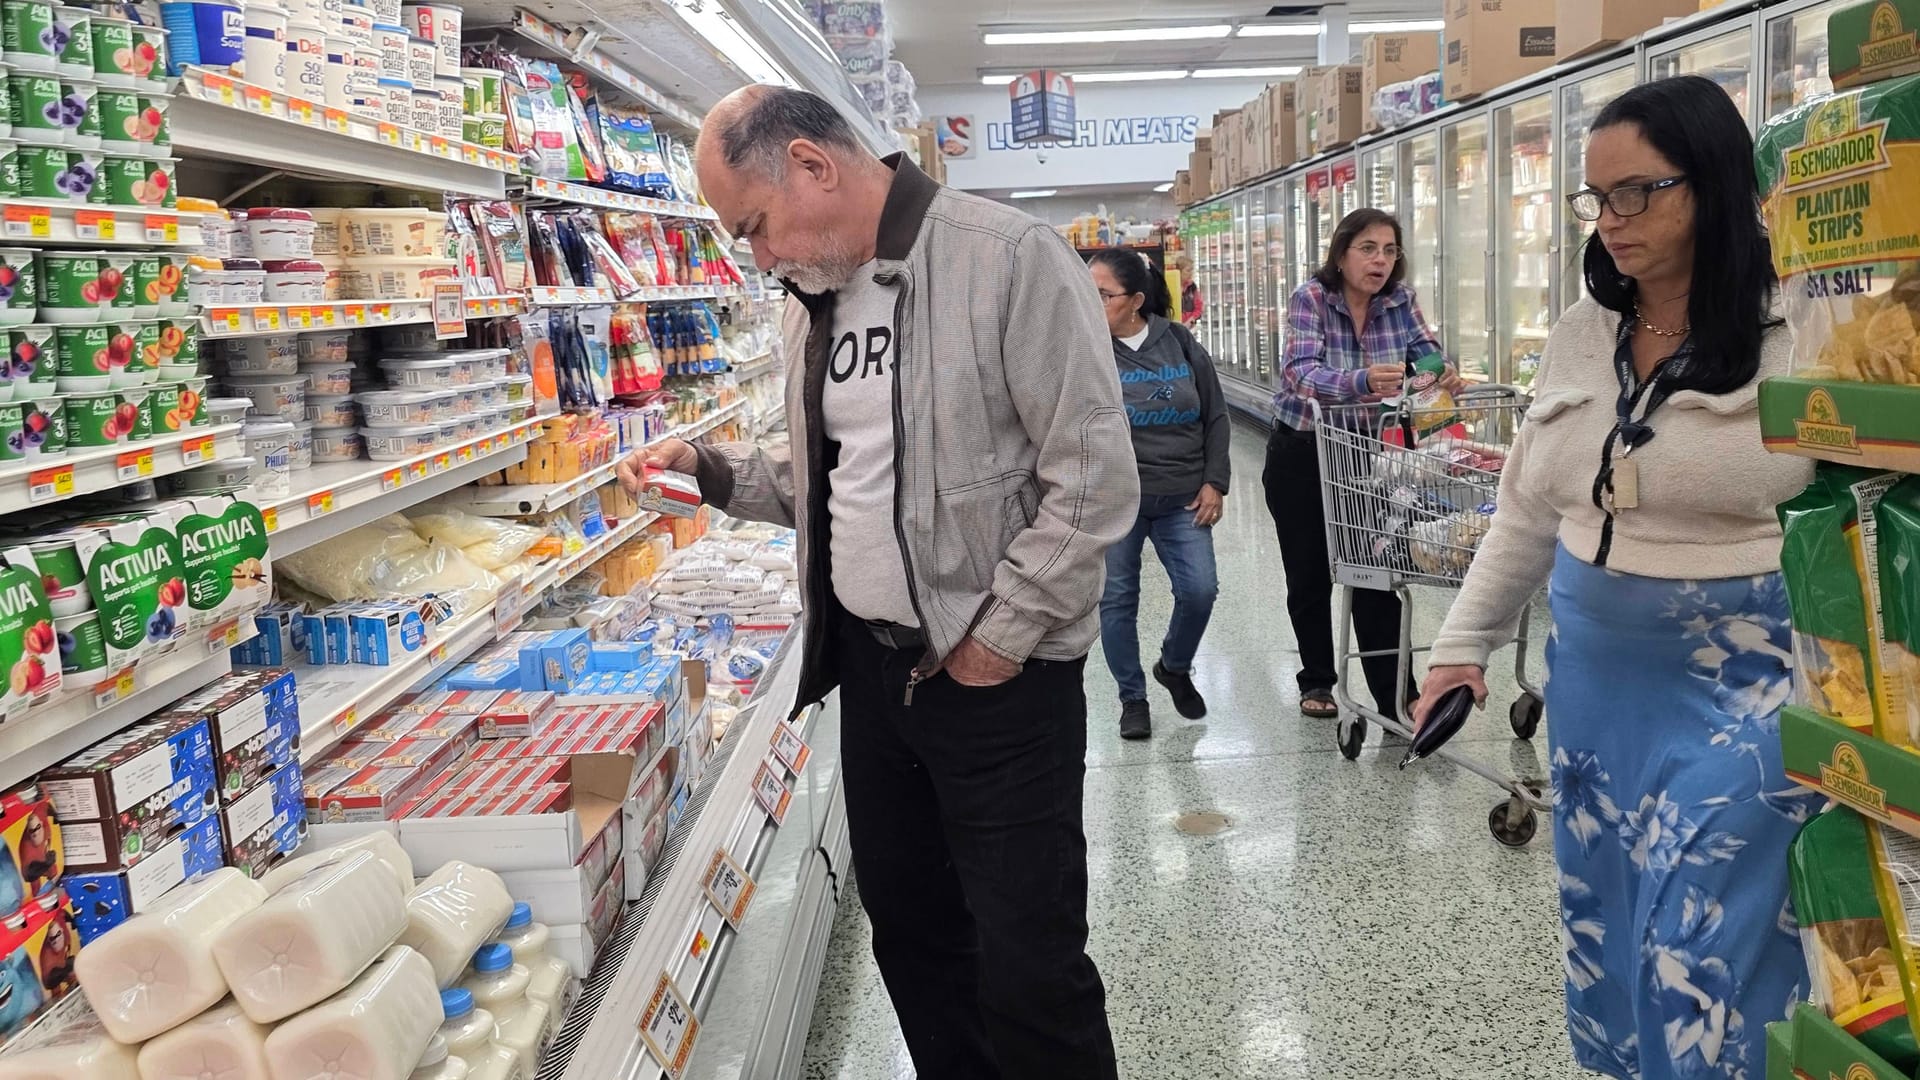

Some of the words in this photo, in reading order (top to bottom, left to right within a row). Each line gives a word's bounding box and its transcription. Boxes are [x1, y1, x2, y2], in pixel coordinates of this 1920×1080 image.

[1870, 38, 1913, 64] SEMBRADOR
[986, 121, 1097, 150] LUH
[1103, 116, 1200, 146] MEATS
[1791, 159, 1800, 176] EL
[1800, 134, 1876, 178] SEMBRADOR
[1796, 181, 1871, 221] PLANTAIN
[1808, 211, 1863, 246] STRIPS
[1840, 244, 1858, 258] CON
[1859, 241, 1874, 255] SAL
[1807, 272, 1829, 299] SEA
[1833, 266, 1875, 296] SALT
[829, 326, 894, 383] OR
[1119, 363, 1190, 384] arolina
[1806, 426, 1850, 447] SEMBRADOR
[1856, 476, 1898, 492] Nutrition
[182, 515, 257, 558] ACTIVIA
[100, 543, 173, 591] ACTIVIA
[192, 583, 203, 603] 3
[112, 619, 124, 641] 3
[1832, 773, 1883, 809] SEMBRADOR
